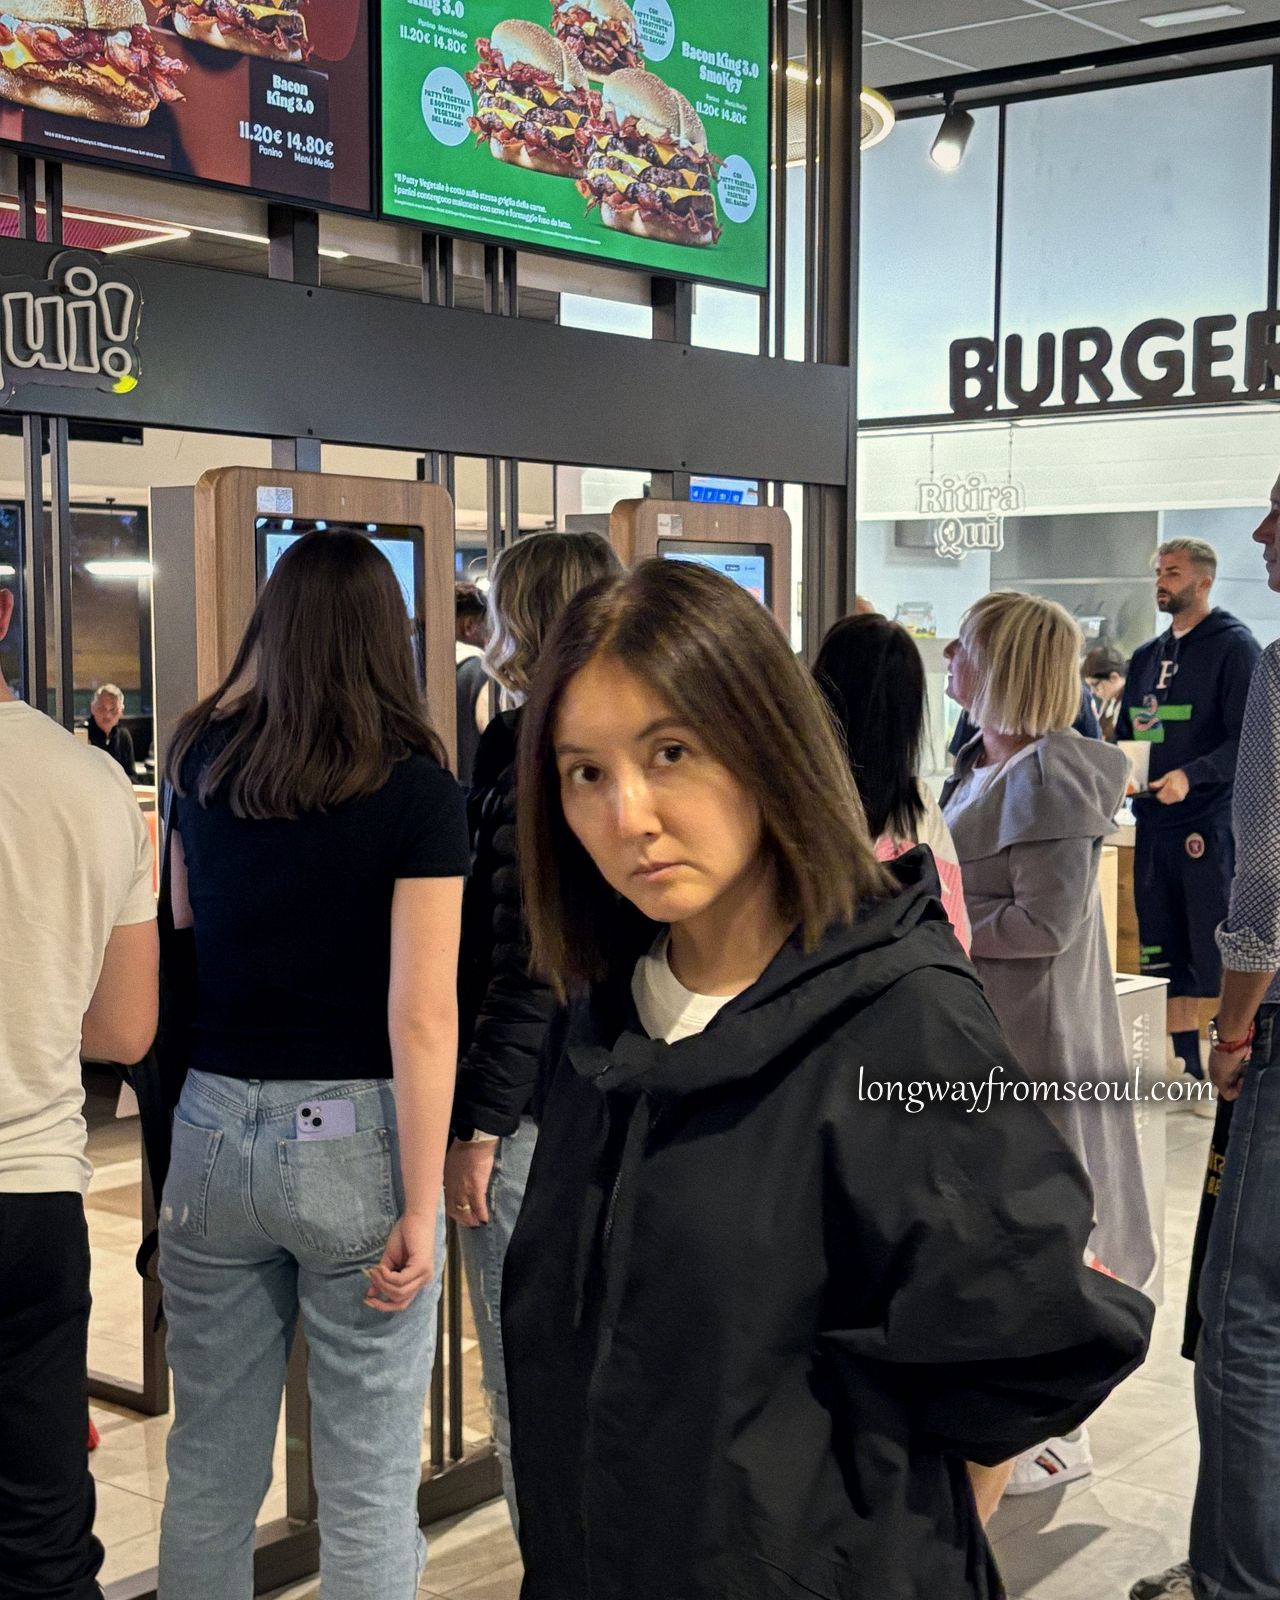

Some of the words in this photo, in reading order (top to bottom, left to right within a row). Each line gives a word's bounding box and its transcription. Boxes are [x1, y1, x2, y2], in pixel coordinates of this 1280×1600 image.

[442, 0, 464, 17] 3.0
[399, 24, 430, 43] 11.20€
[433, 34, 467, 53] 14.80€
[681, 40, 715, 65] Bacon
[715, 51, 741, 76] King
[742, 60, 759, 78] 3.0
[272, 74, 308, 96] Bacon
[441, 85, 453, 93] CON
[266, 89, 295, 113] King
[295, 97, 314, 114] 3.0
[239, 120, 282, 144] 11.20€
[286, 131, 334, 156] 14.80€
[258, 144, 283, 158] Panino
[313, 156, 334, 169] Medio
[418, 177, 444, 191] Vegetale
[0, 266, 135, 389] ui!
[948, 309, 1280, 416] BURGER
[918, 476, 1022, 514] Ritira
[936, 513, 1004, 557] Qui
